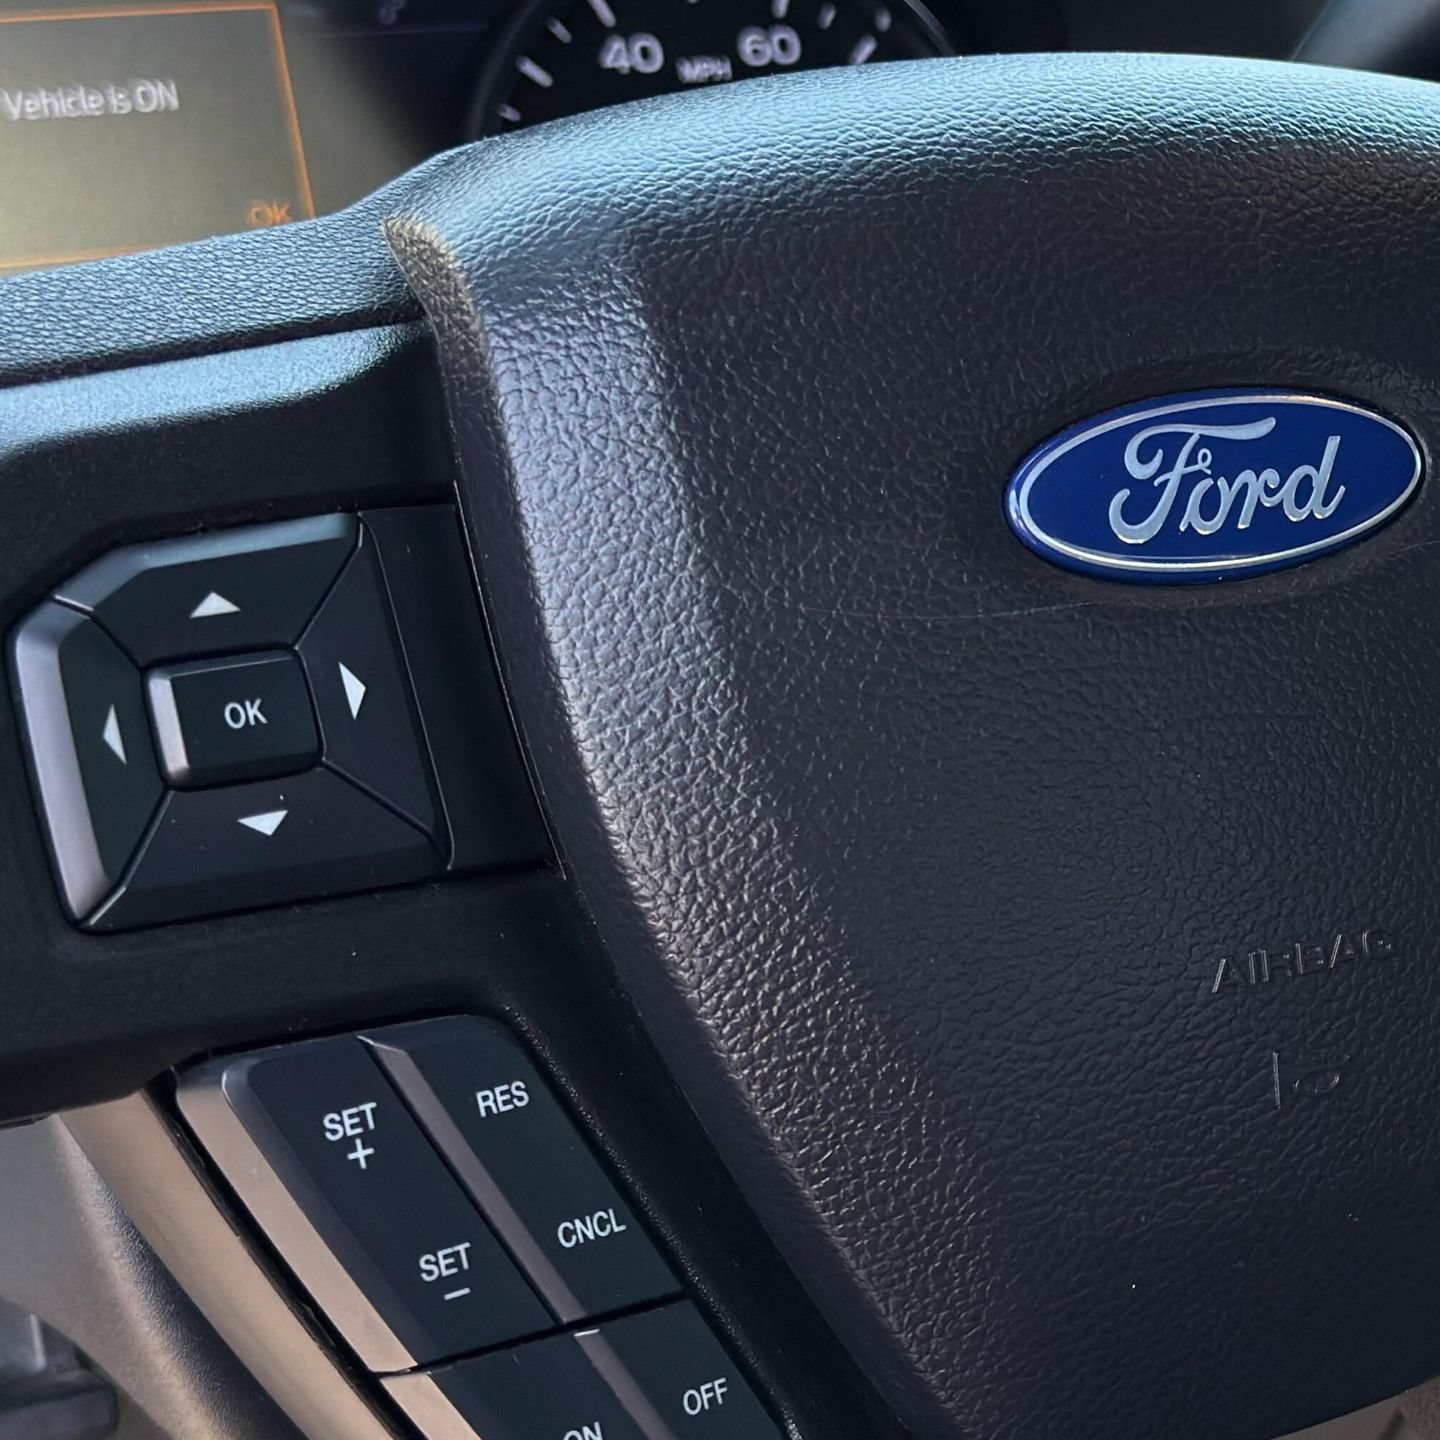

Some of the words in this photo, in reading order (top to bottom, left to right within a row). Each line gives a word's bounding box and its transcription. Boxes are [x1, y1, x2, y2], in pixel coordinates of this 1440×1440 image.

[599, 32, 664, 75] 40
[737, 24, 802, 67] 60
[109, 84, 133, 115] is
[133, 77, 180, 113] ON
[246, 198, 291, 228] OK
[1108, 417, 1347, 545] Ford
[224, 698, 268, 730] OK
[476, 1080, 530, 1118] RES
[322, 1101, 378, 1141] SET
[556, 1208, 627, 1249] CNCL
[418, 1242, 472, 1283] SET
[682, 1377, 729, 1416] OFF
